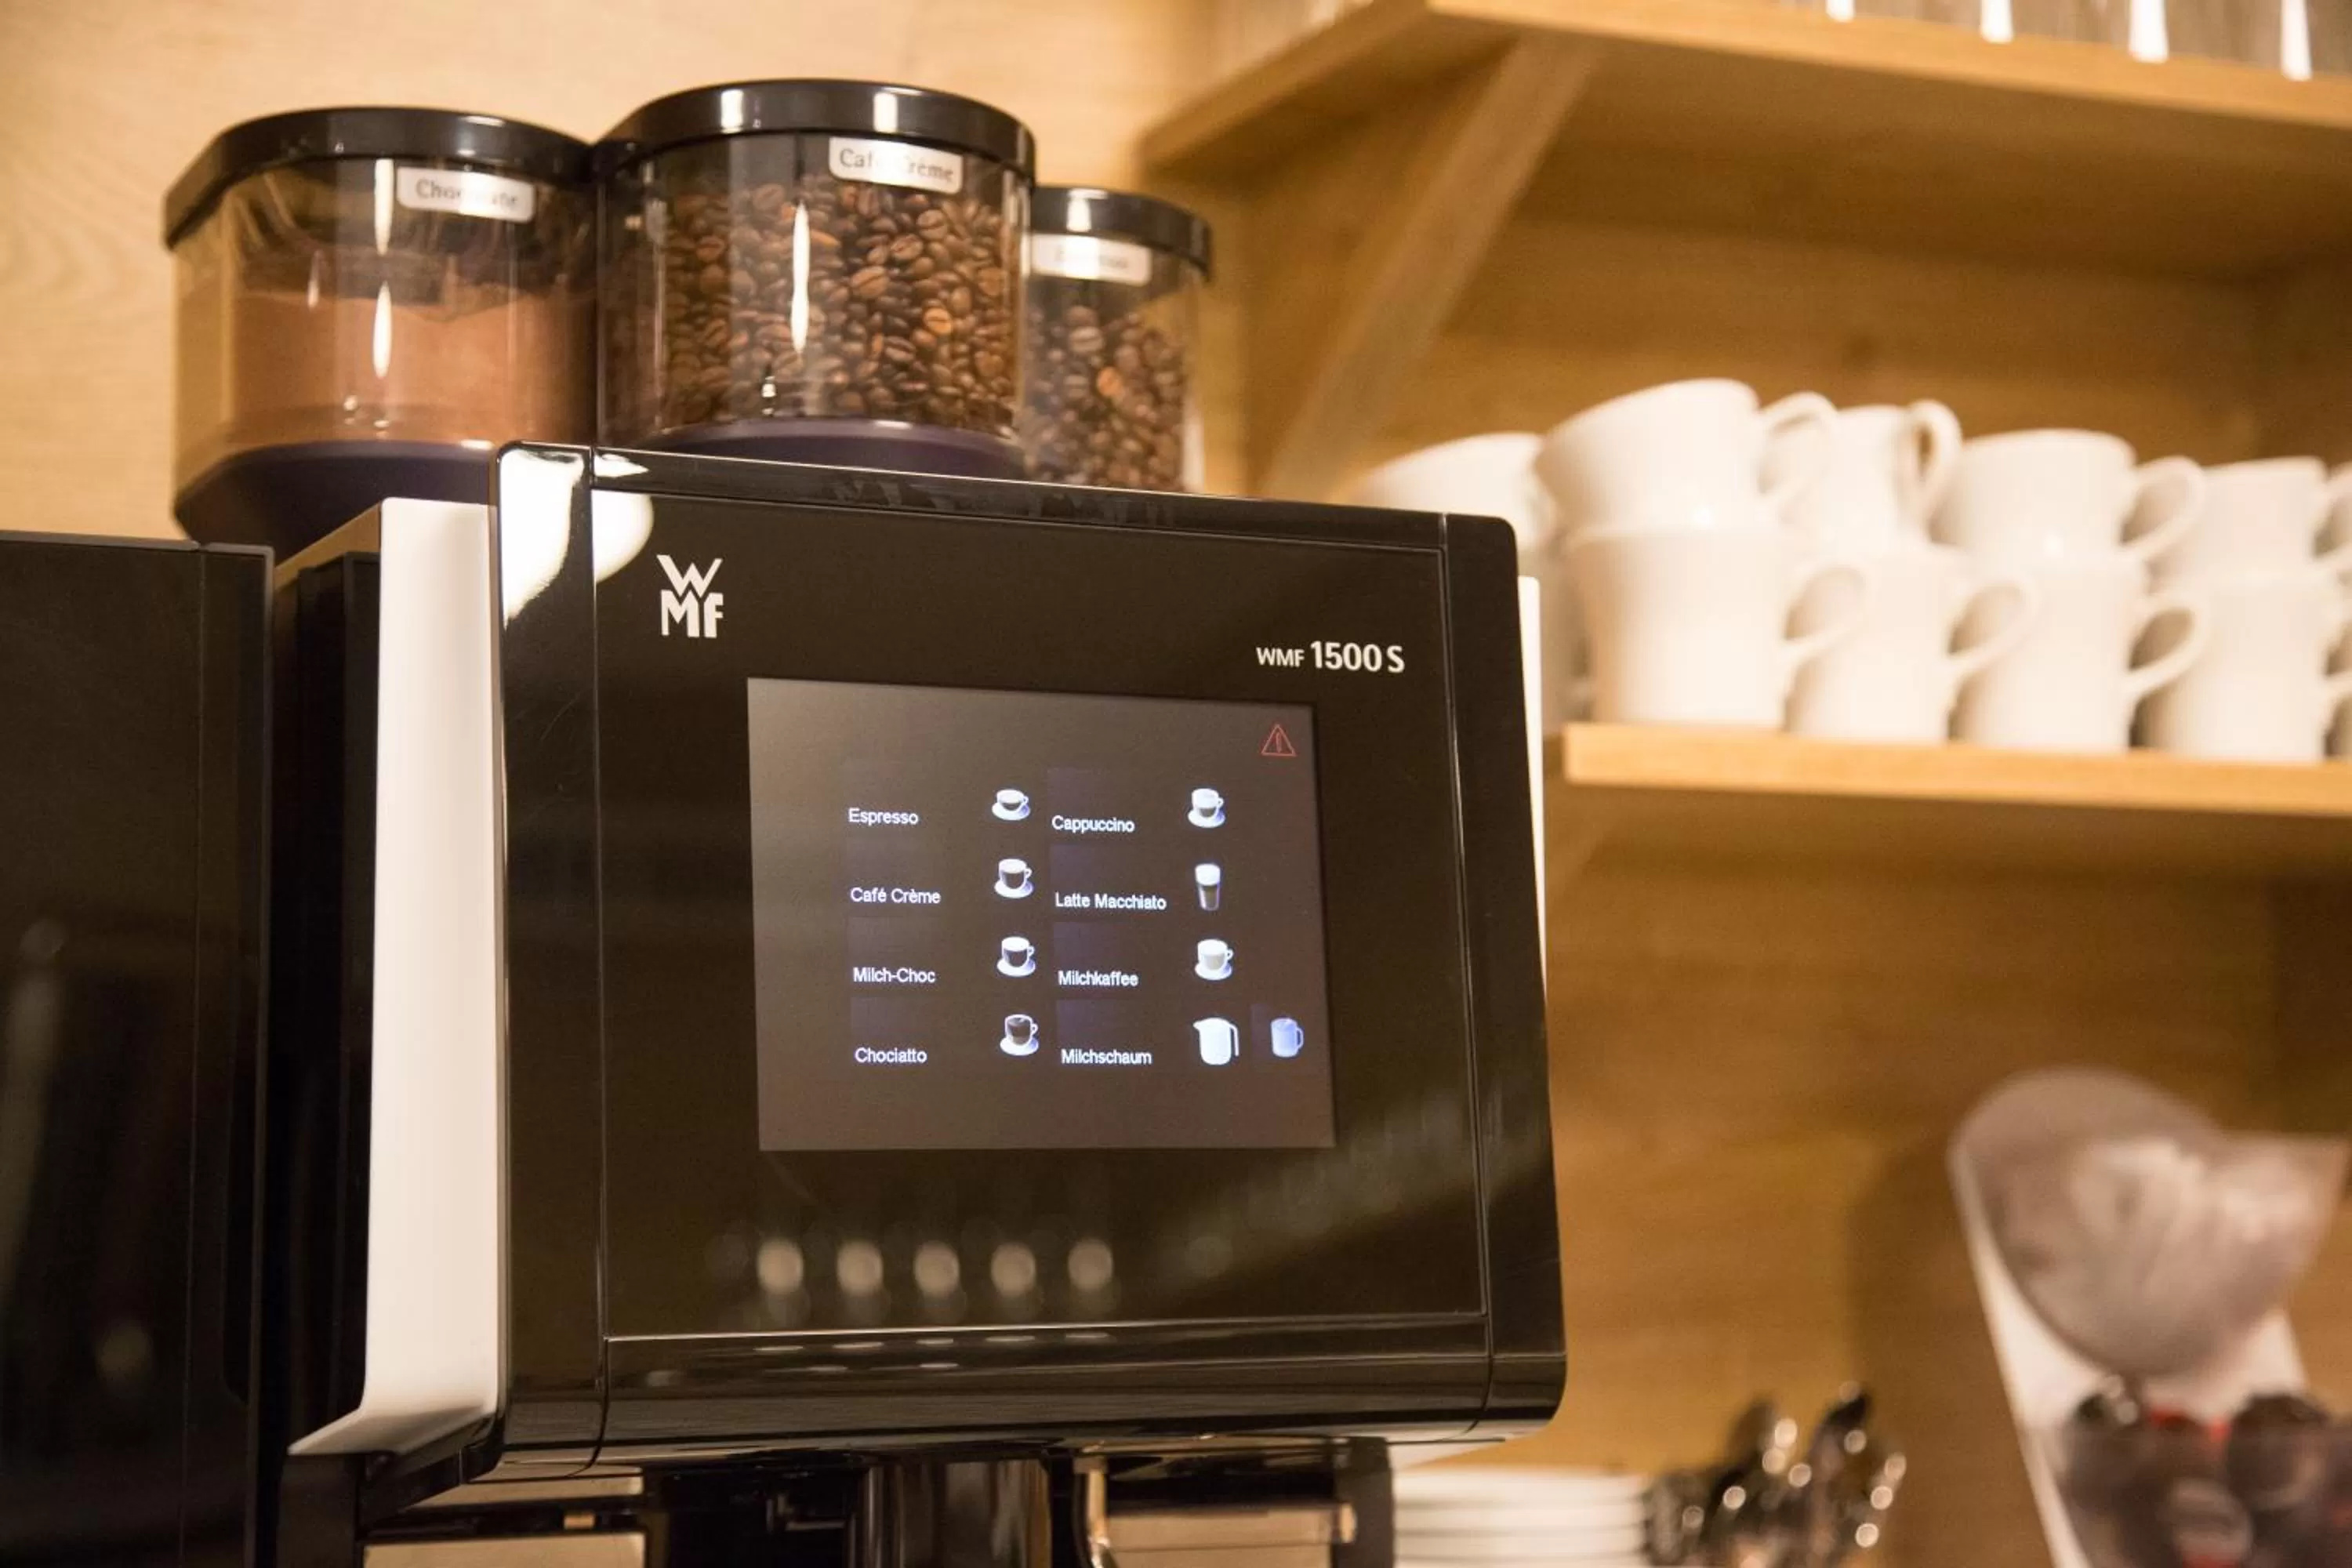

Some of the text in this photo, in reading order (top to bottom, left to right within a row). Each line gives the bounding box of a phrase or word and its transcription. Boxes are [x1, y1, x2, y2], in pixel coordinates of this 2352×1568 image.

[656, 554, 724, 639] WMF
[1256, 640, 1405, 673] WMF 1500 S
[848, 808, 919, 826] Espresso
[1051, 815, 1135, 834] Cappuccino
[850, 887, 941, 904] Café Crème
[1055, 892, 1167, 910] Latte Macchiato
[853, 967, 935, 983] Milch-Choc
[1058, 970, 1139, 986] Milchkaffee
[855, 1047, 927, 1064] Chociatto
[1061, 1048, 1152, 1065] Milchschaum
